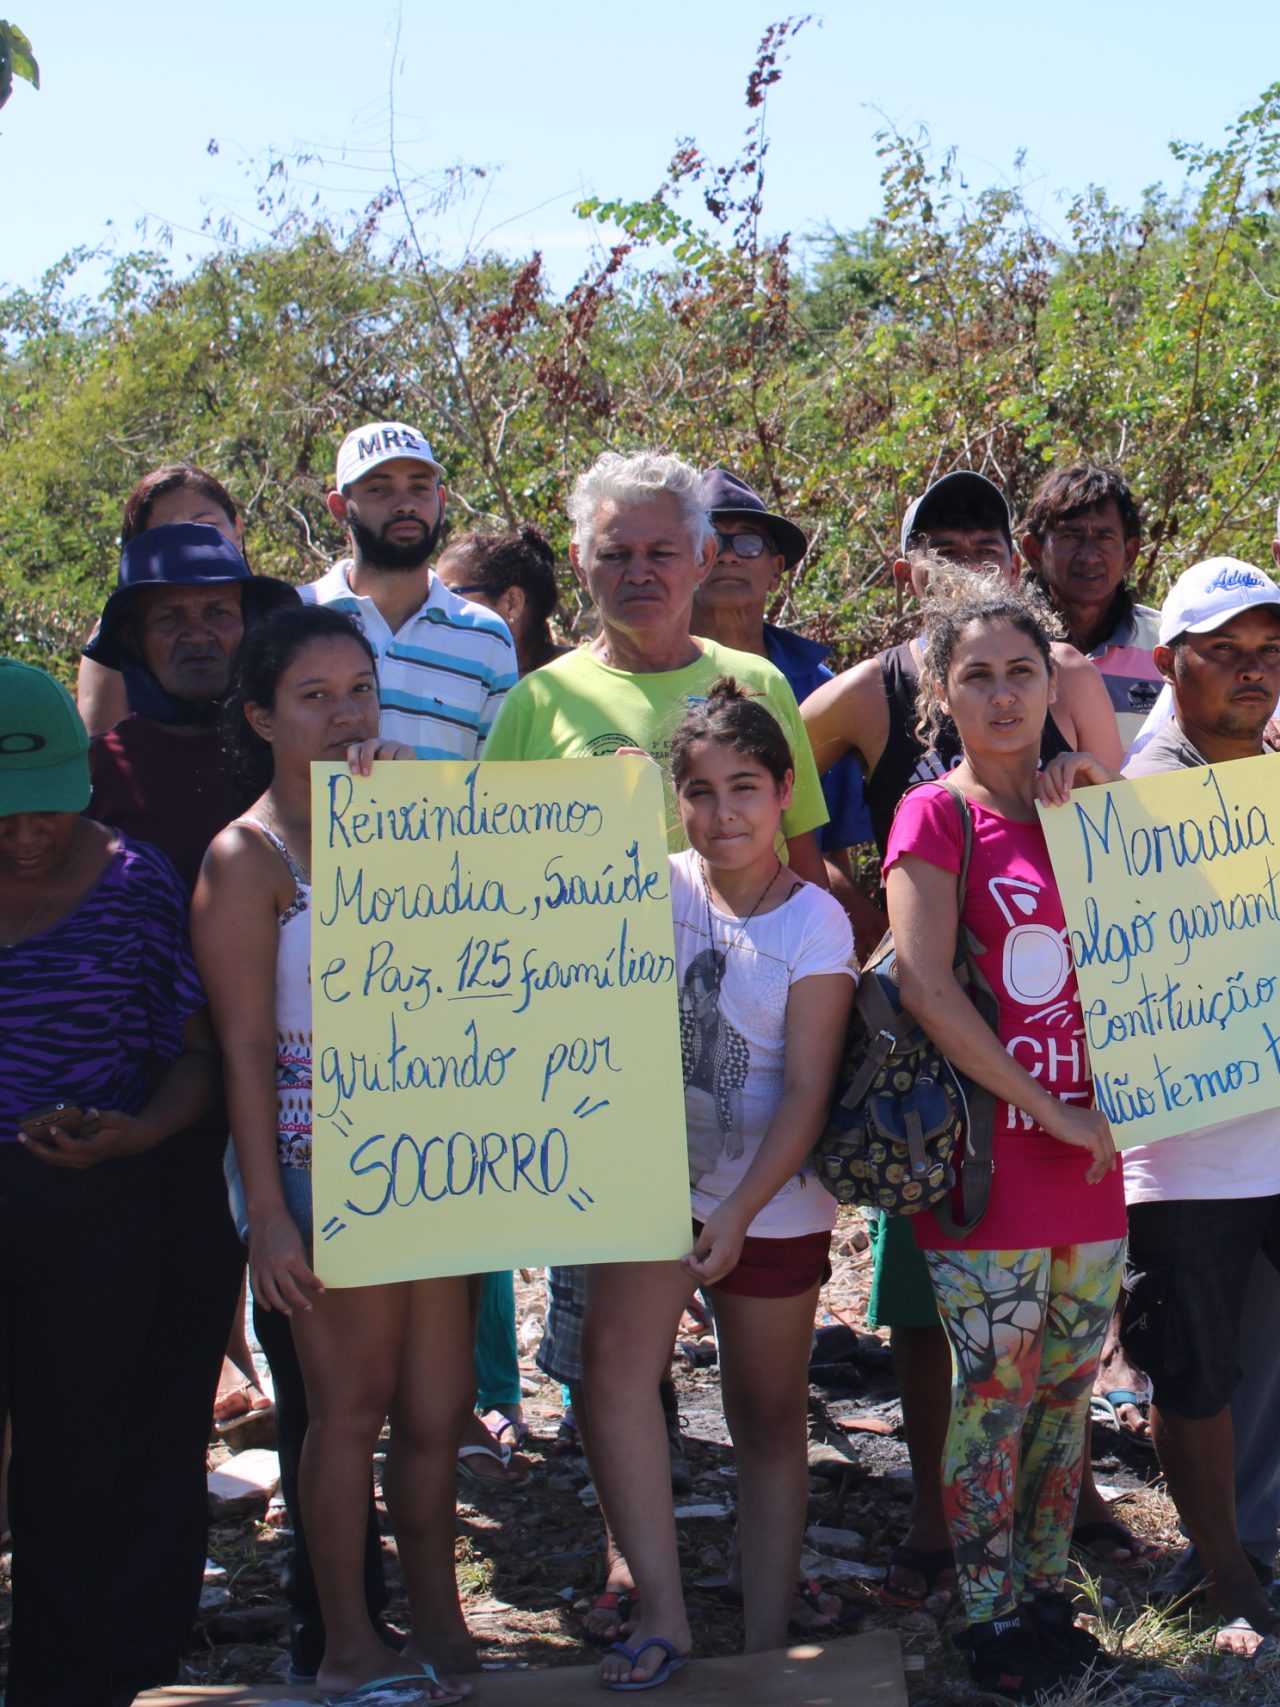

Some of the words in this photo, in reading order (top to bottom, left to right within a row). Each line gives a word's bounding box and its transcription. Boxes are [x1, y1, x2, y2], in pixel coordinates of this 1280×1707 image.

[1074, 769, 1275, 883] Moradia
[320, 958, 351, 1002] e
[363, 940, 443, 1011] Paz.
[456, 936, 512, 993] 125
[512, 917, 674, 1013] famílias
[1070, 897, 1158, 984] algo
[1084, 972, 1278, 1050] Contituição
[317, 1012, 516, 1118] gritando
[542, 1037, 623, 1102] por
[1154, 1054, 1260, 1111] temos
